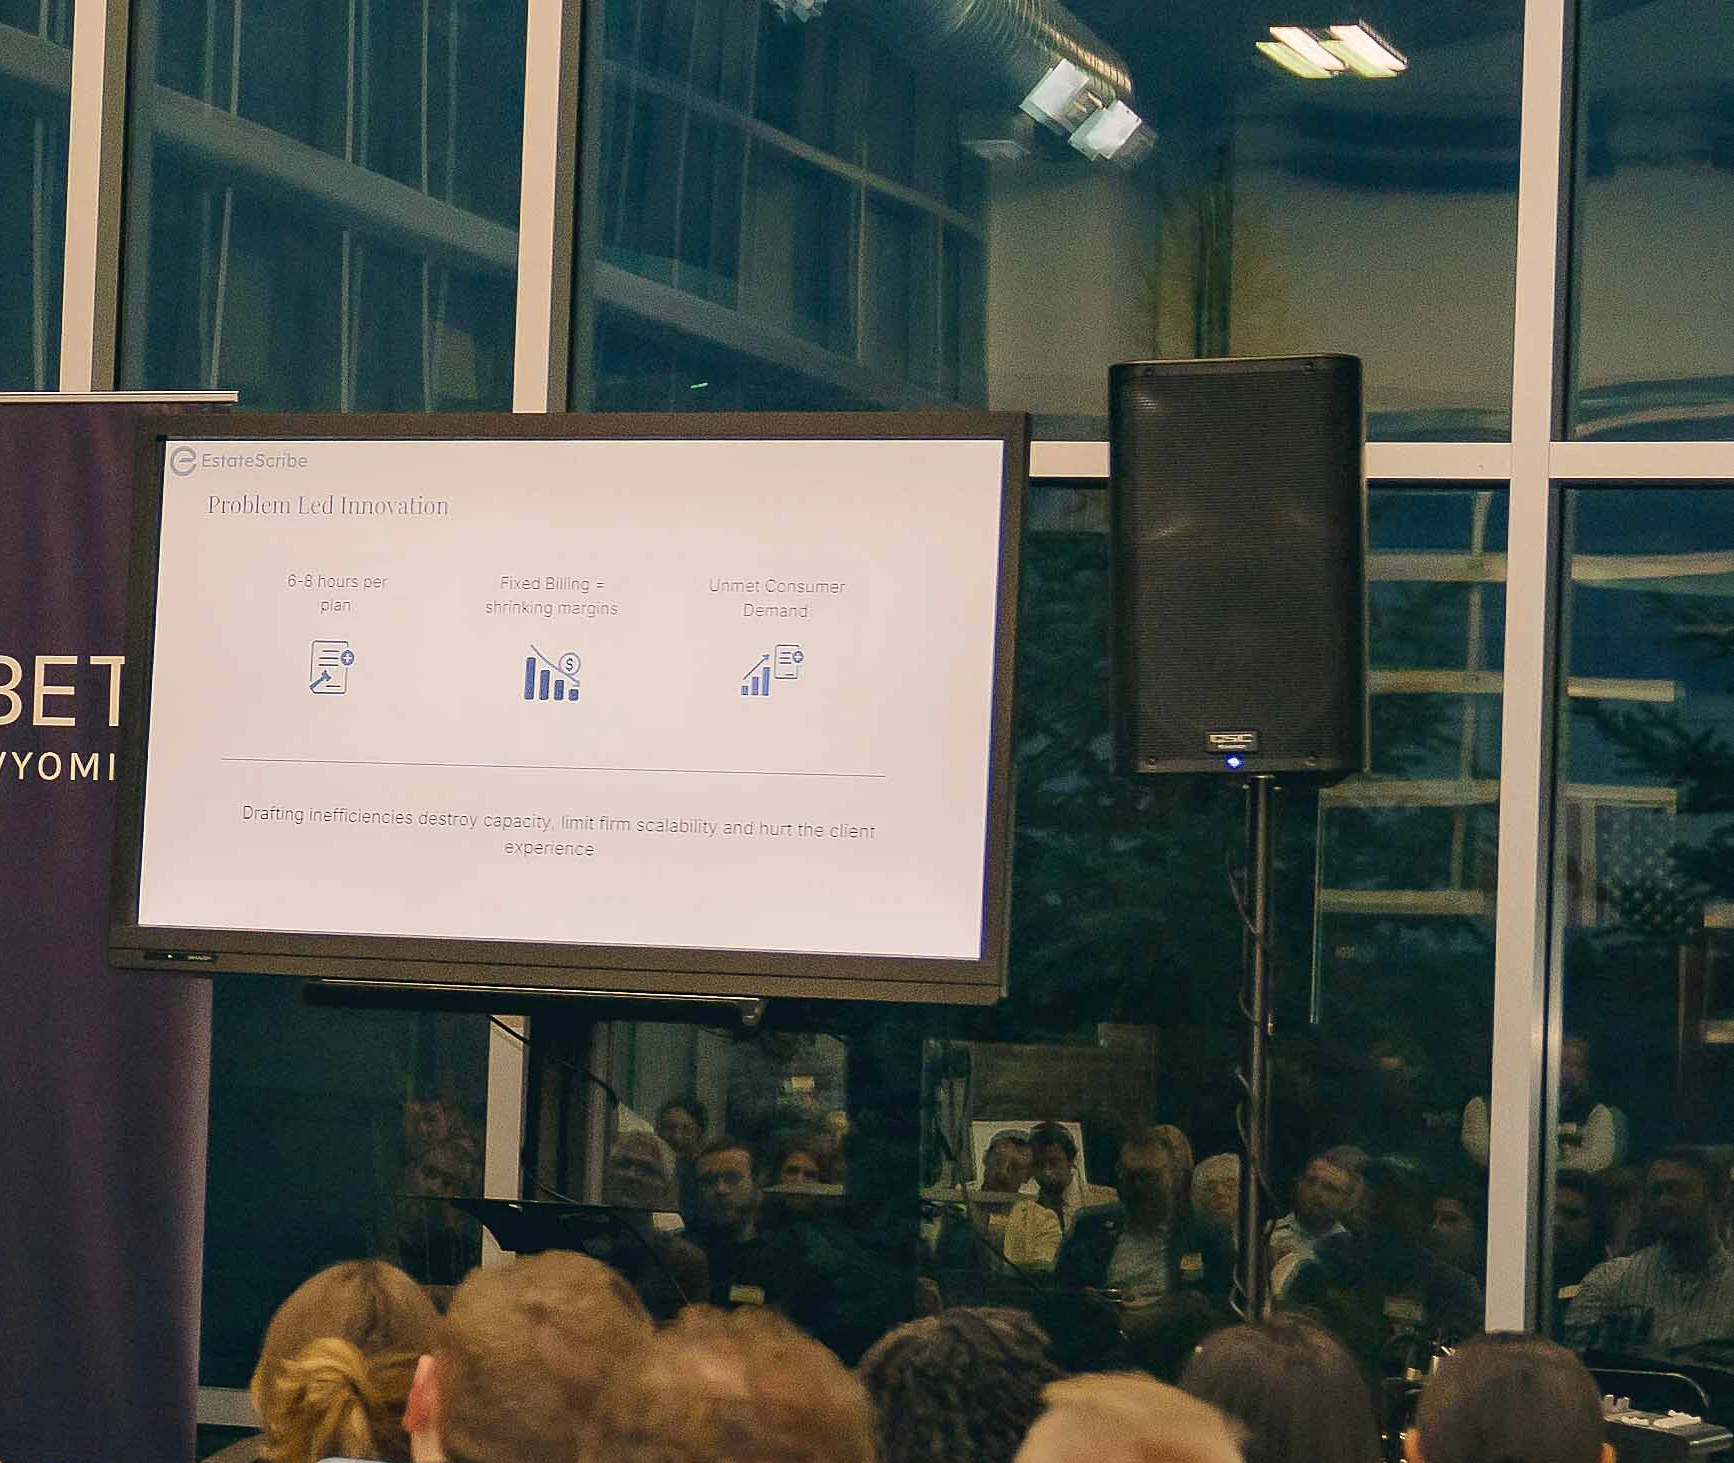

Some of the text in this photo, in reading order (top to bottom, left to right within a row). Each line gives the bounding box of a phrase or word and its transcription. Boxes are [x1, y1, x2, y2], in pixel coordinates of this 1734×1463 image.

[201, 453, 308, 468] EstateScribe
[207, 495, 448, 515] Problem Led Innovation
[287, 574, 388, 591] 6-8 hours per
[500, 576, 540, 590] Fixed
[545, 576, 589, 594] Billing
[709, 578, 845, 594] Unmet Consumer
[320, 599, 351, 614] plan
[485, 601, 618, 618] shrinking margins
[743, 603, 808, 618] Demand
[242, 805, 876, 839] Drafting inefficiencies destroy capacity, limit firm scalability and hurt the client
[504, 840, 595, 857] experience
